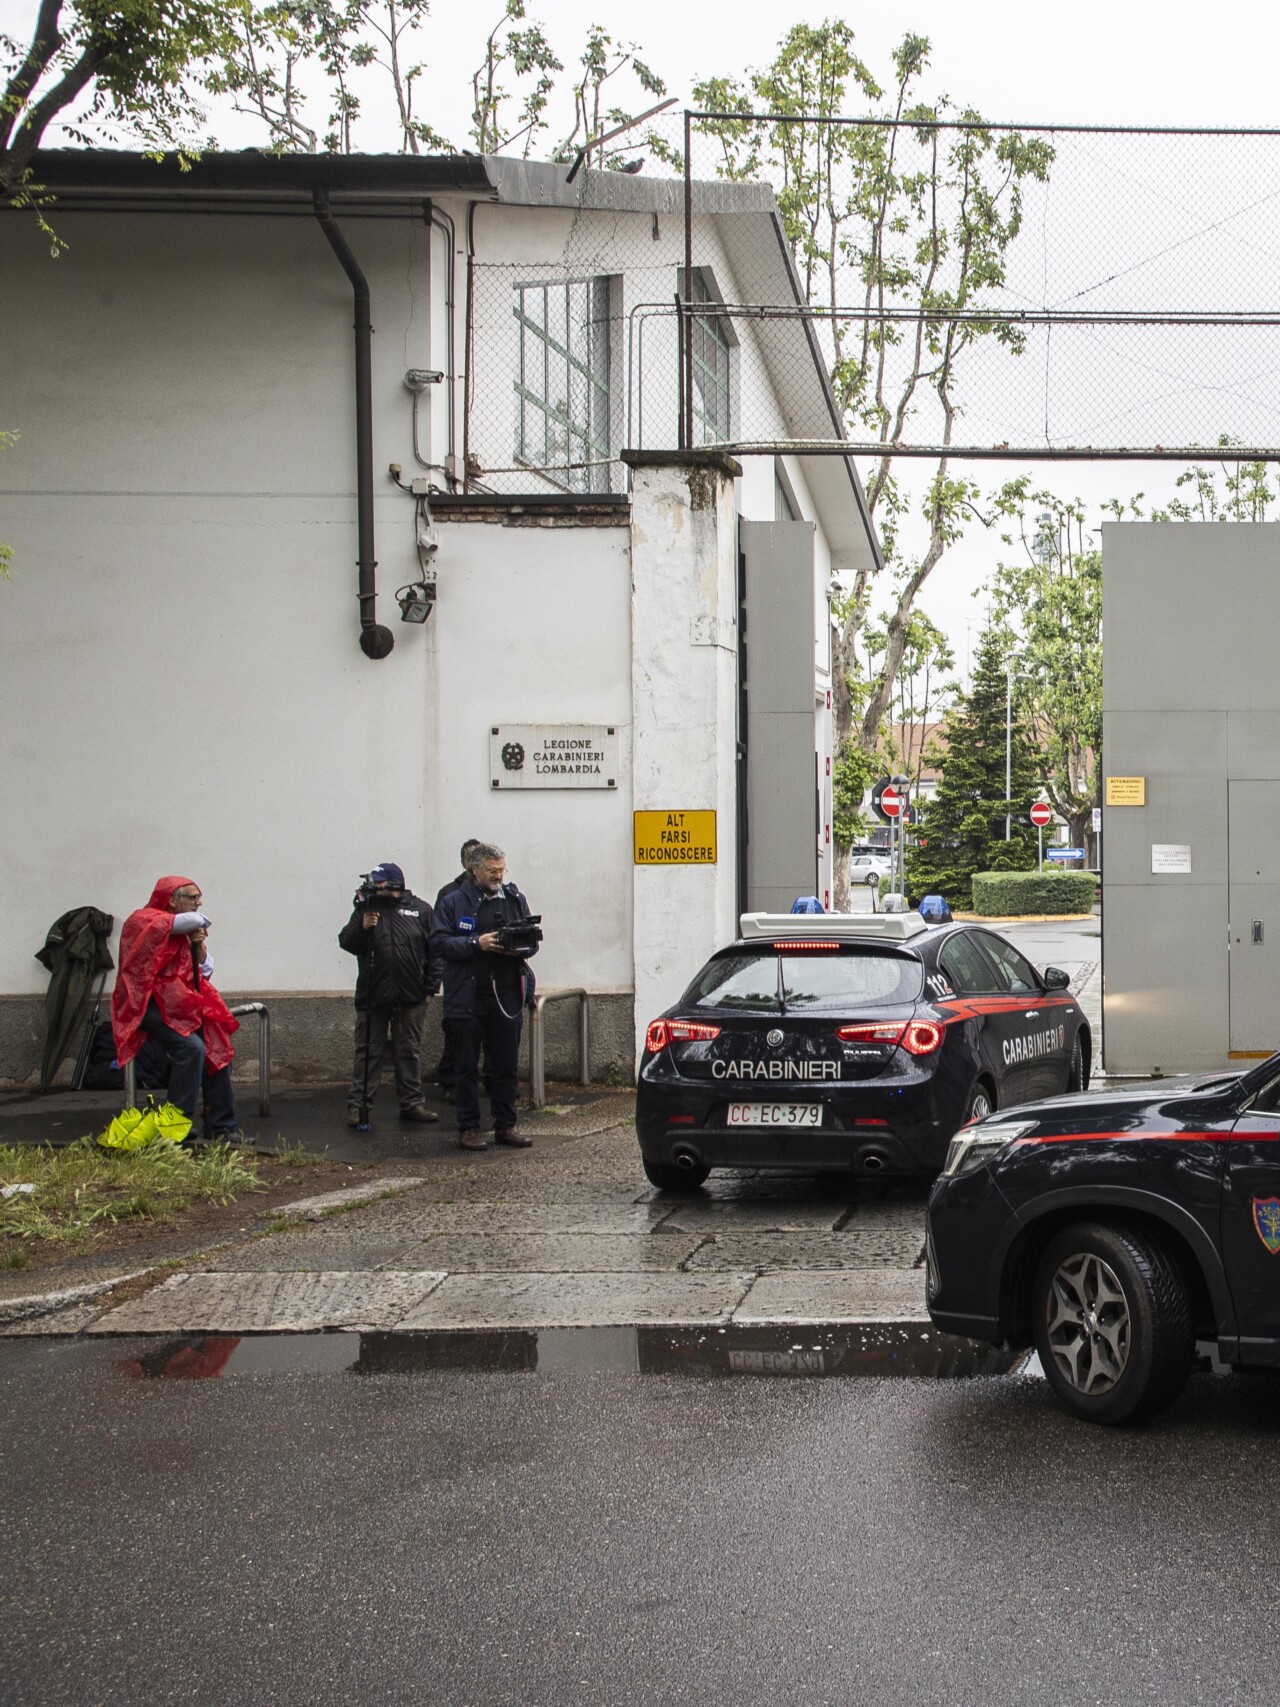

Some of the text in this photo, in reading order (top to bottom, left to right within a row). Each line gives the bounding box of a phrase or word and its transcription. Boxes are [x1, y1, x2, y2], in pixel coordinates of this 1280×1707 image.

[543, 739, 592, 749] LEGIONE
[532, 752, 605, 761] CARABINIERI
[535, 764, 602, 774] LOMBARDIA
[666, 814, 685, 827] ALT
[661, 830, 691, 844] FARSI
[638, 847, 713, 861] RICONOSCERE
[926, 974, 954, 996] 112
[1002, 1028, 1059, 1066] CARABINIERI
[711, 1060, 841, 1079] CARABINIERI
[731, 1105, 819, 1123] CC EC 379
